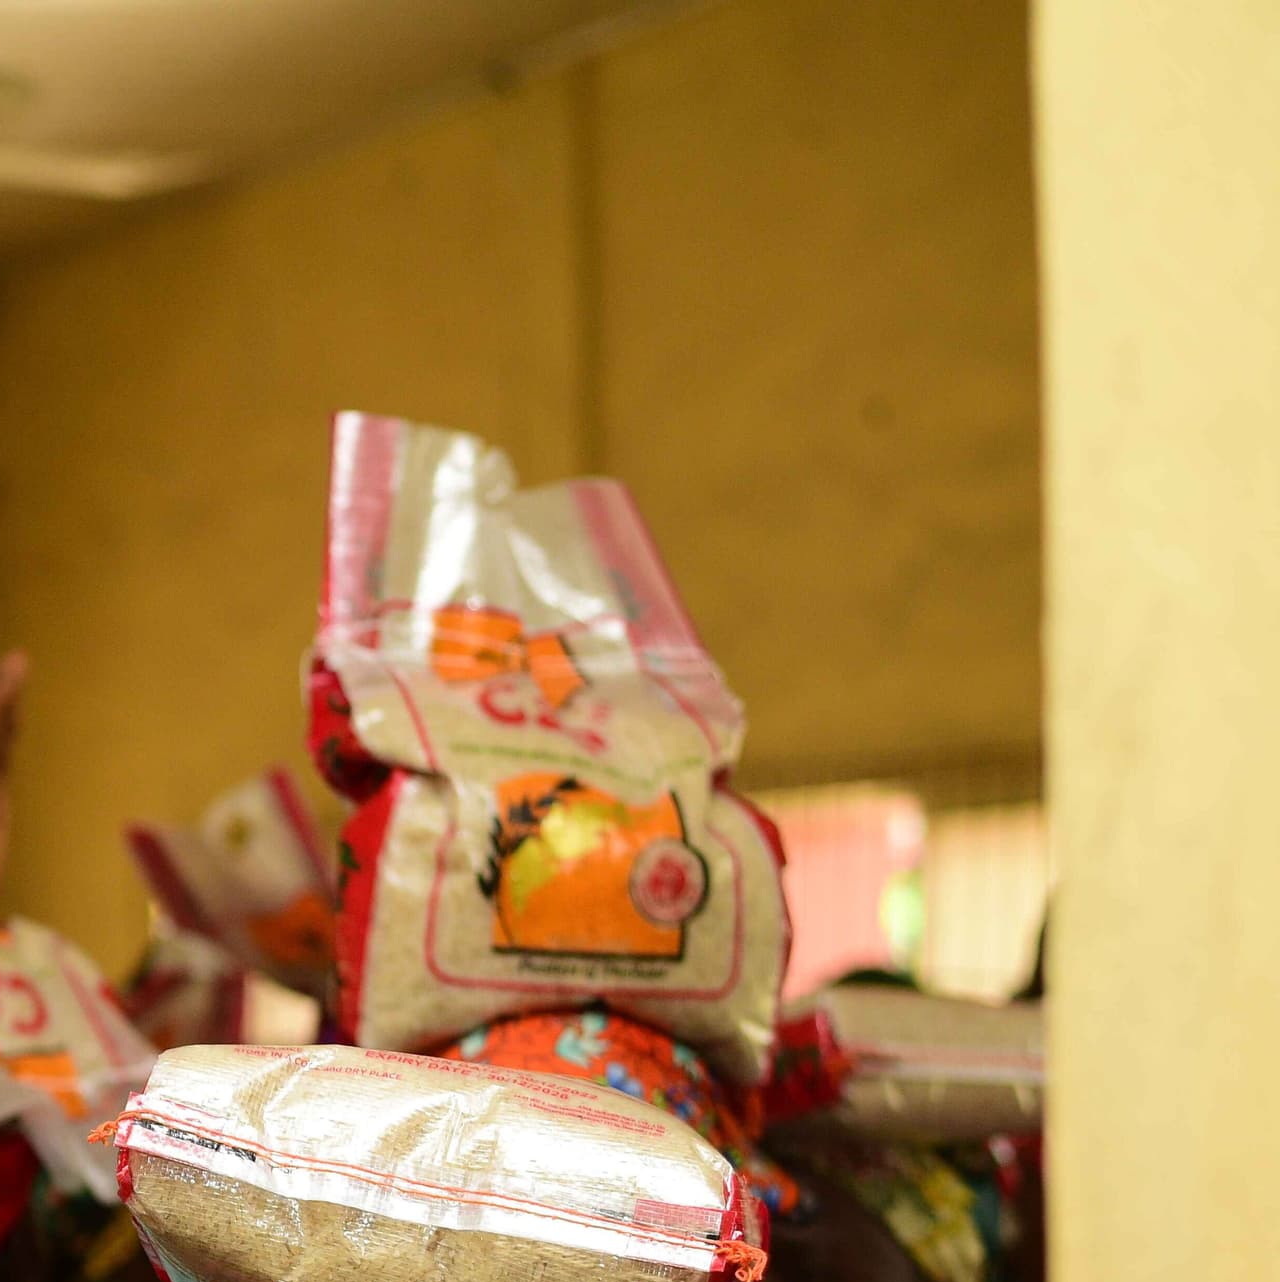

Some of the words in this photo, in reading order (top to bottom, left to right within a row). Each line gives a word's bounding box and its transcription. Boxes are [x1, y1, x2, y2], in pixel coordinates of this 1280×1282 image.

[364, 1050, 425, 1069] EXPIRY
[426, 1063, 473, 1076] DATE
[369, 1070, 402, 1080] PLACE
